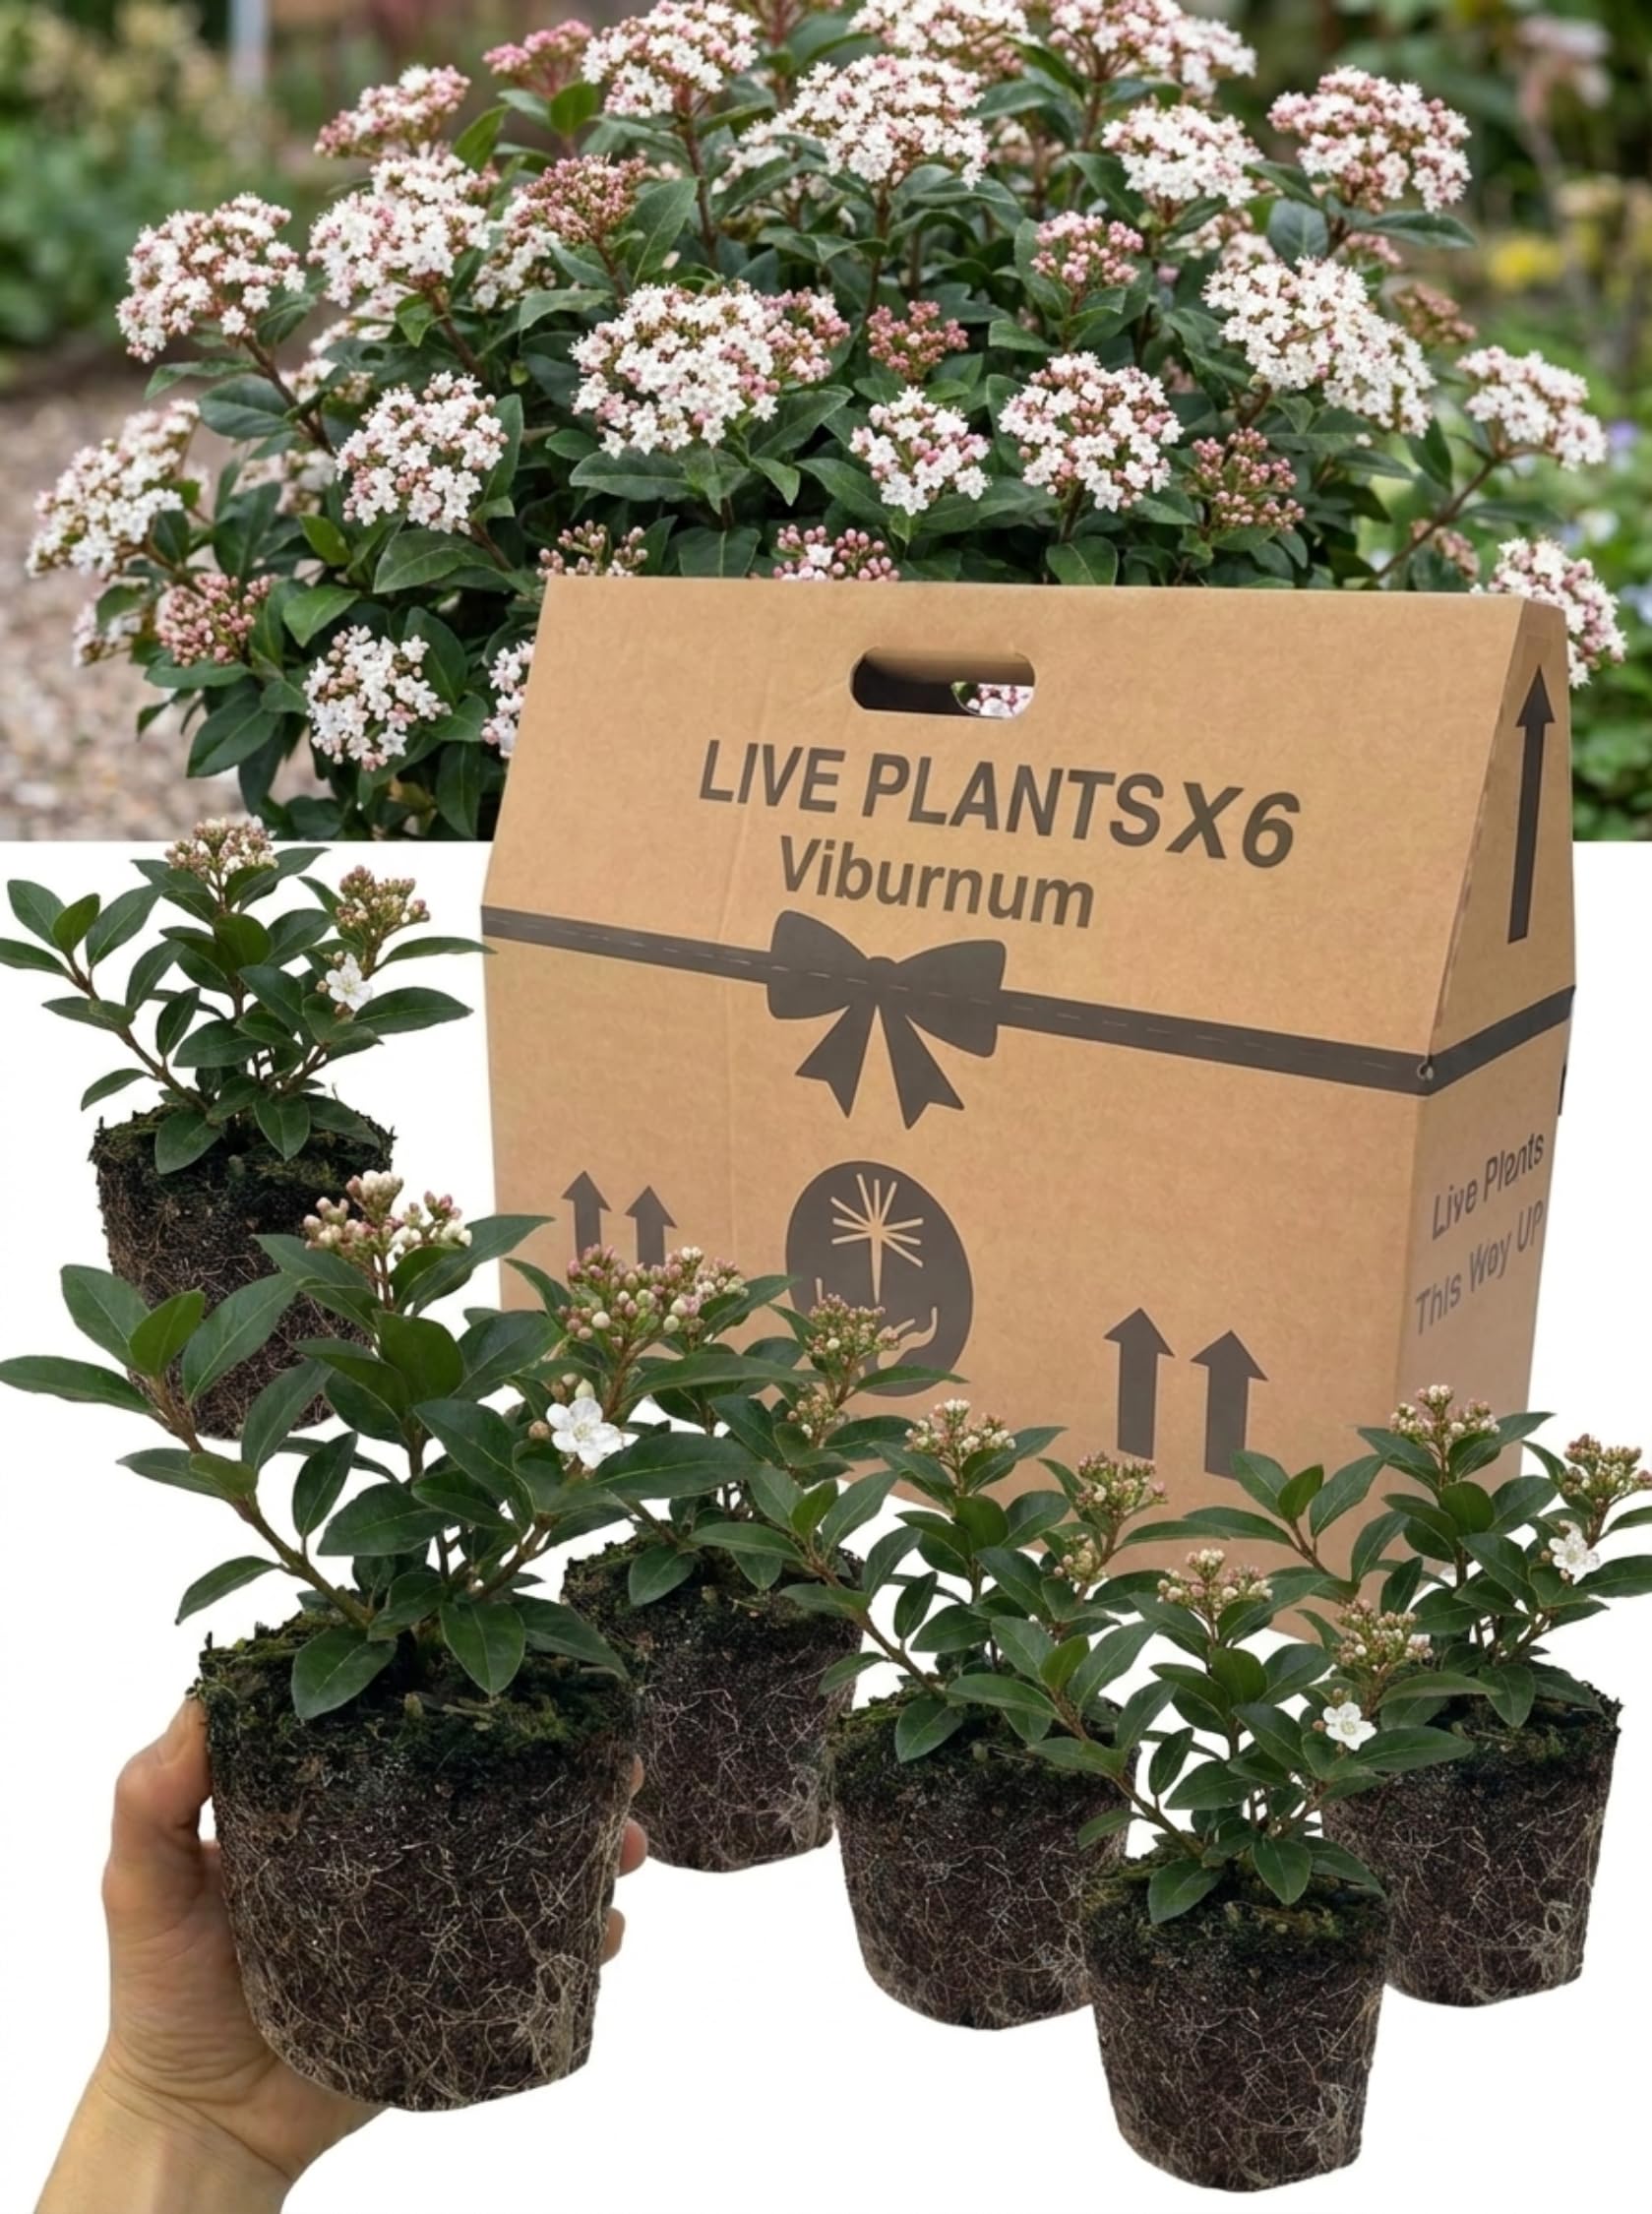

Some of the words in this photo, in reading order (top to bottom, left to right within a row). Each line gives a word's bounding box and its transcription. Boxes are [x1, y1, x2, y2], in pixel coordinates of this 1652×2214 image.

[699, 739, 845, 812] LIVE
[862, 752, 1165, 847] PLANTS
[1165, 781, 1301, 869] X6
[779, 835, 1095, 928] Viburnum
[1433, 1178, 1478, 1241] Live
[1484, 1133, 1545, 1202] Plants
[1415, 1273, 1461, 1335] This
[1469, 1232, 1512, 1293] Way
[1516, 1199, 1544, 1253] UP
